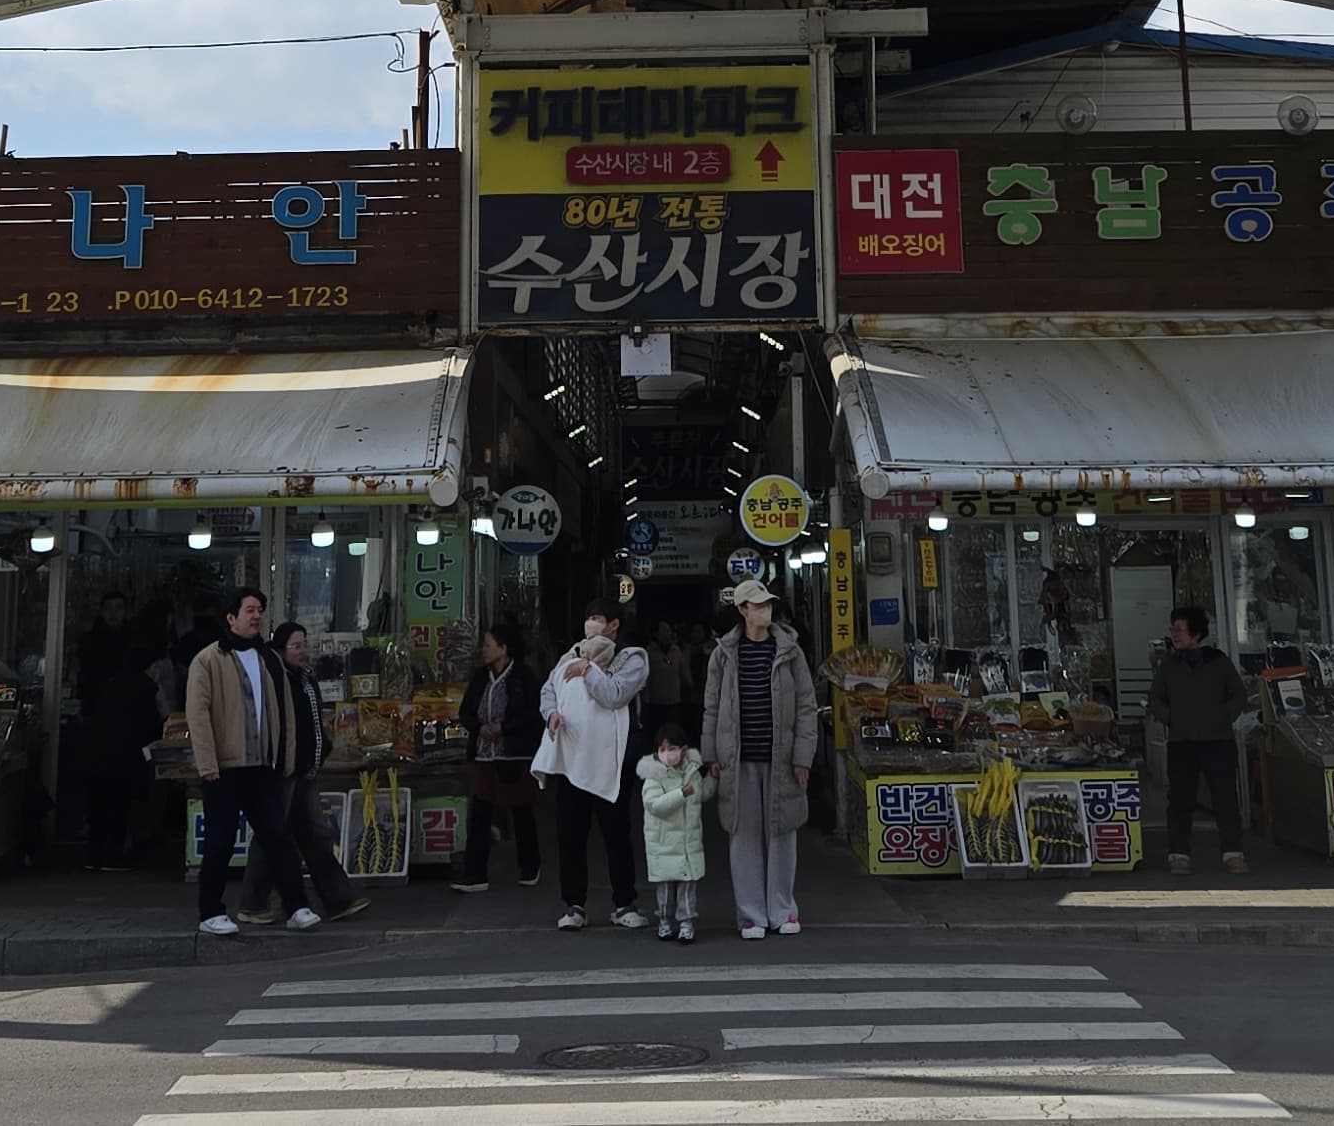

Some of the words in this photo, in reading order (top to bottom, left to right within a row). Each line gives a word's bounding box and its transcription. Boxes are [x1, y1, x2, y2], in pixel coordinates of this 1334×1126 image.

[488, 84, 805, 142] 커피테마파크
[575, 152, 647, 175] 수산시장
[653, 152, 673, 174] 내
[683, 149, 723, 175] 2층
[562, 195, 642, 229] 80년
[656, 194, 730, 231] 전통
[850, 171, 946, 222] 대전
[983, 162, 1169, 246] 충남
[858, 232, 947, 257] 배오징어
[479, 231, 810, 314] 수산시장
[497, 507, 558, 536] 가나안
[746, 497, 773, 513] 충남
[777, 497, 804, 512] 공주
[877, 783, 956, 824] 반건
[411, 809, 457, 853] 갈
[882, 825, 959, 867] 오징
